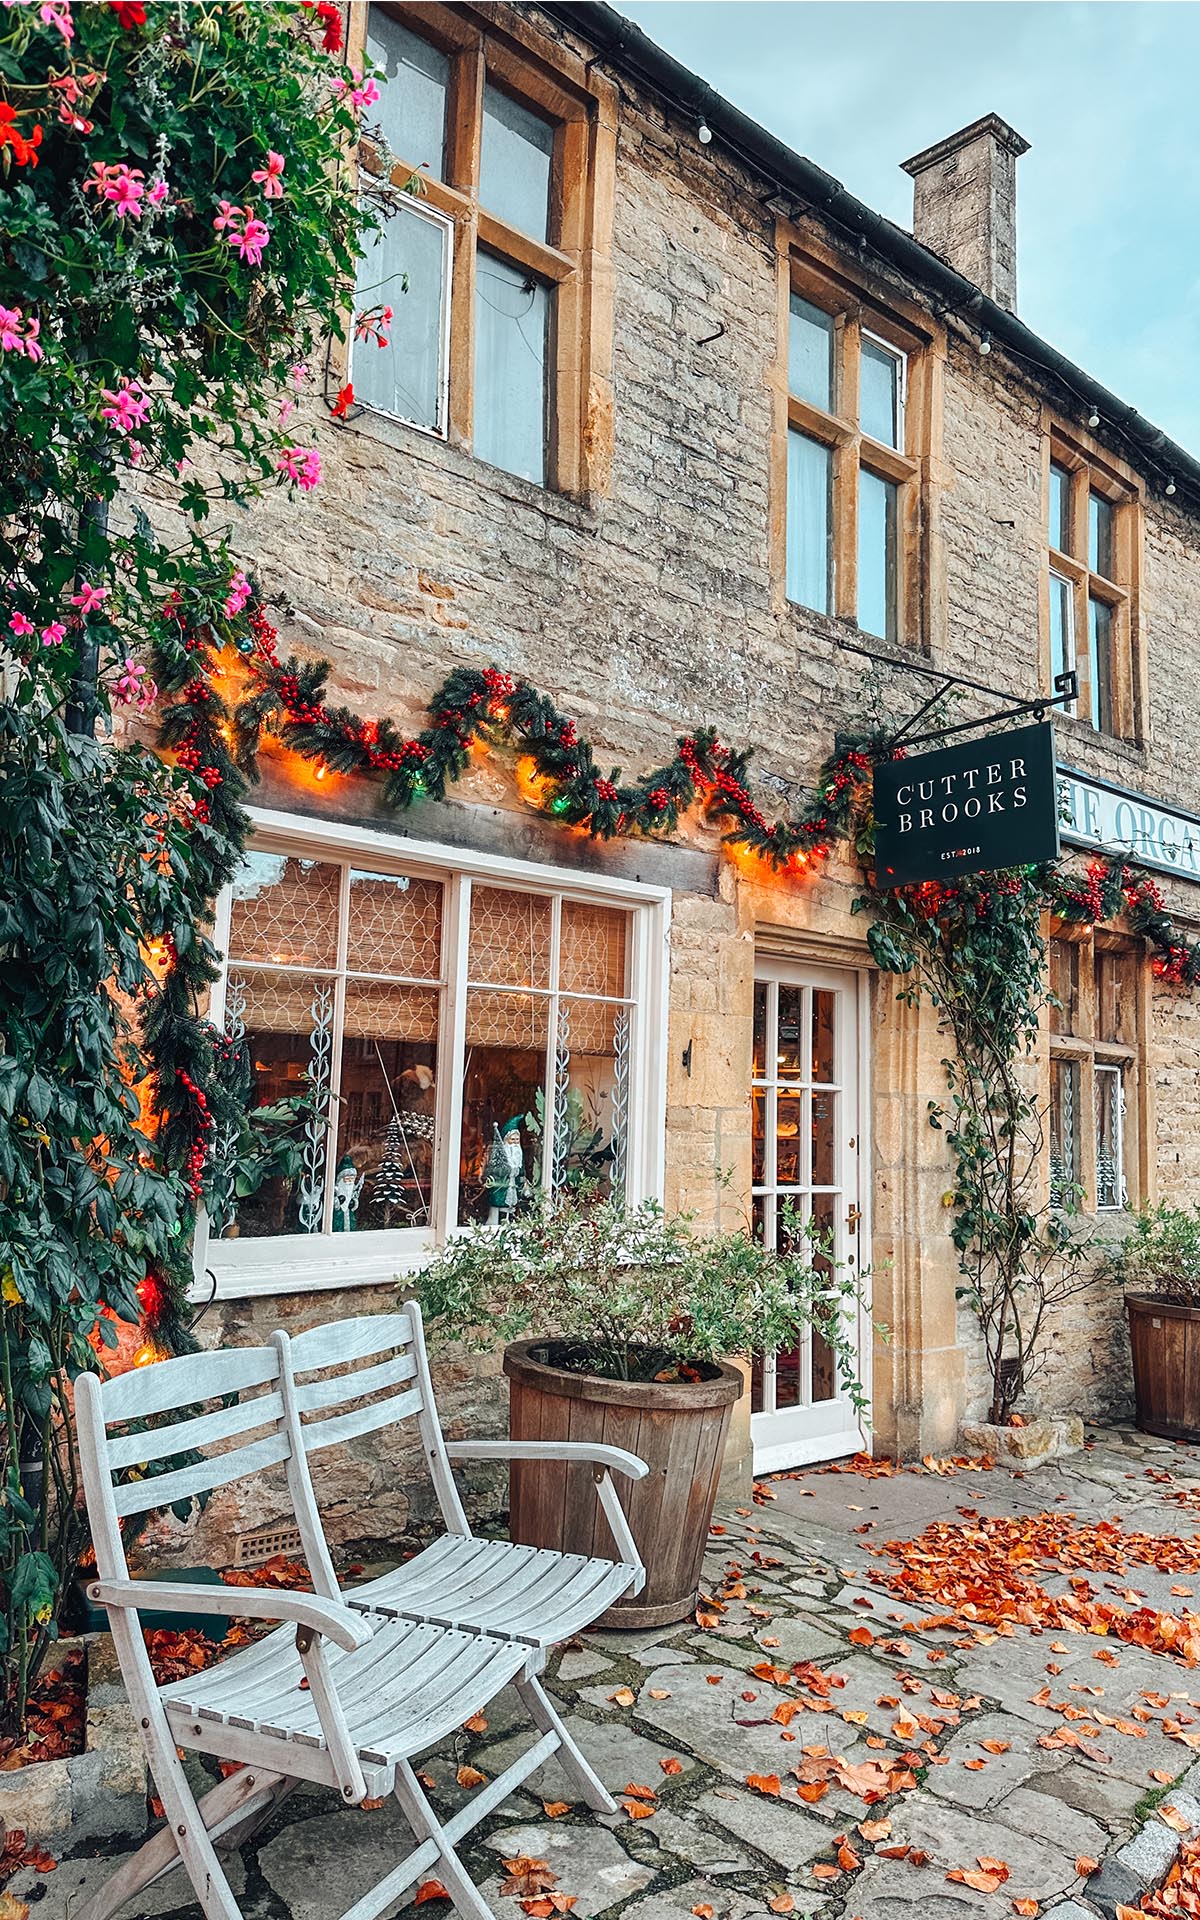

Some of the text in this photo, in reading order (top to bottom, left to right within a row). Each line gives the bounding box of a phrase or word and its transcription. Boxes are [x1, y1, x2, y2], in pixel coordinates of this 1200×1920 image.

[896, 758, 1028, 805] CUTTER
[898, 786, 1028, 833] BROOKS
[940, 846, 981, 860] EST. 2018
[1115, 801, 1200, 872] ORGA
